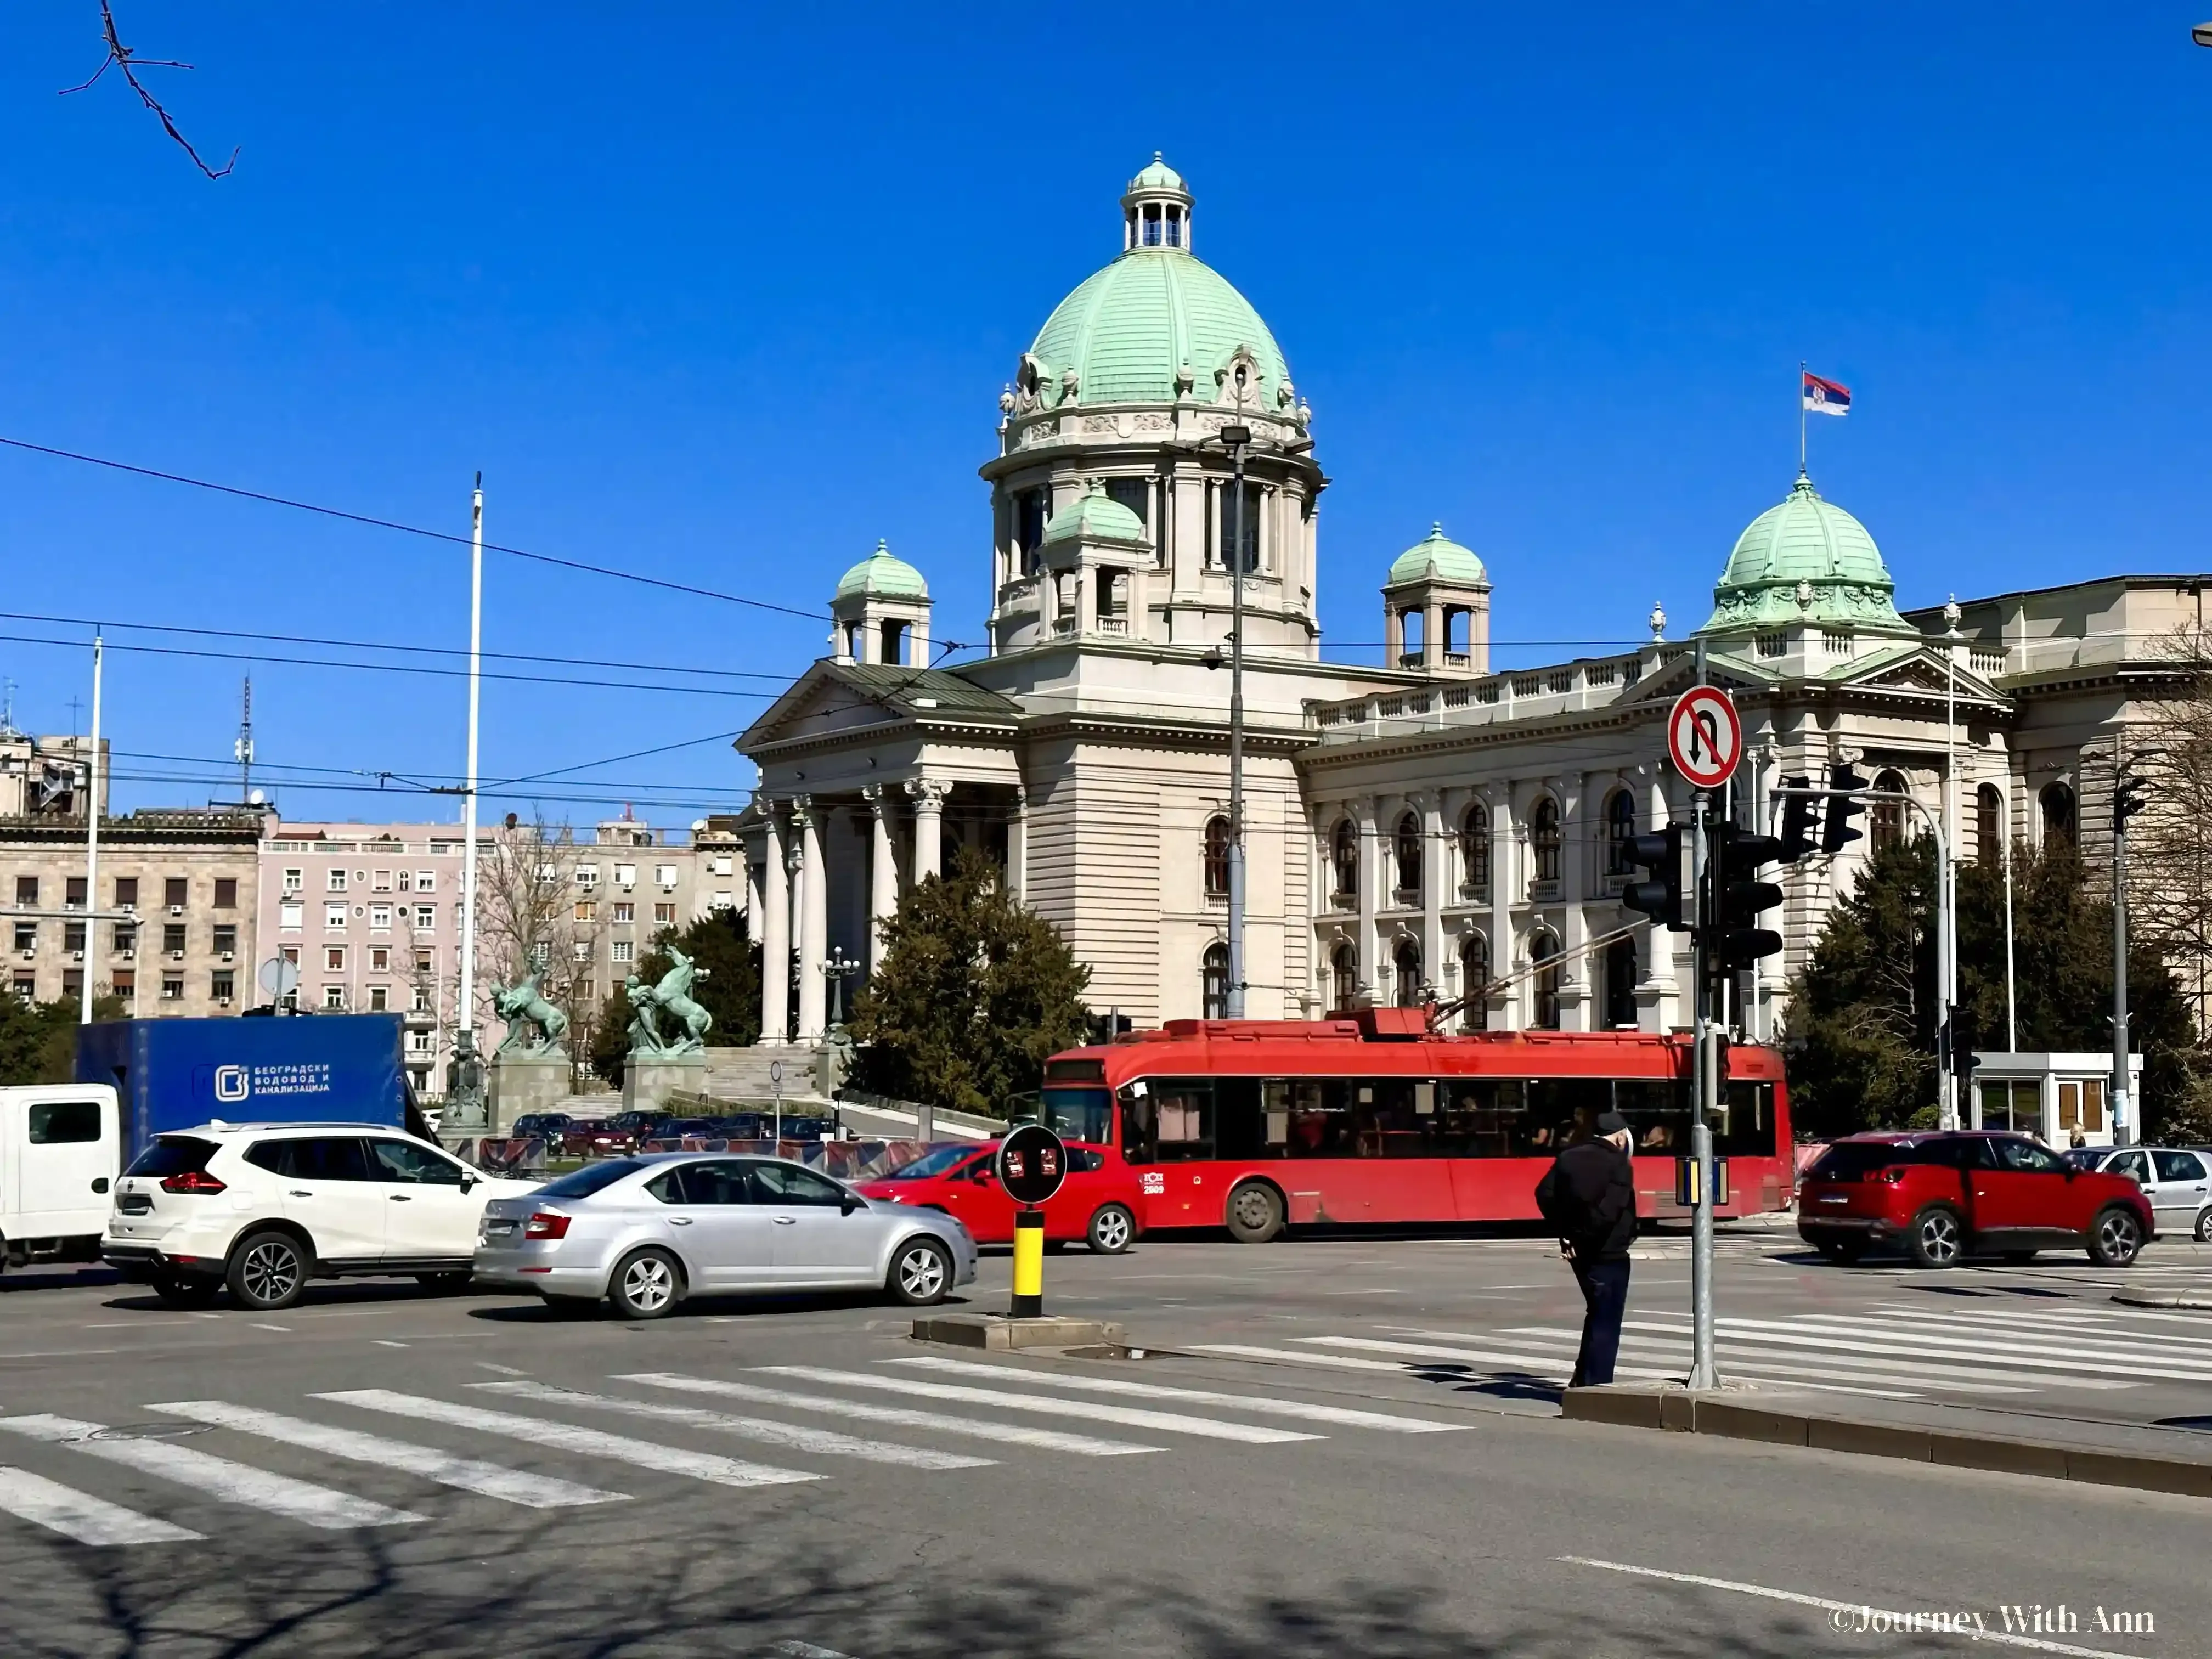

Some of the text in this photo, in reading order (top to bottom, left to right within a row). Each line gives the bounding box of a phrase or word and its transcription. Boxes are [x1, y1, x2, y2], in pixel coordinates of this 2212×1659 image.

[254, 1064, 329, 1075] БЕОГРАДСКИ
[255, 1075, 315, 1085] ВОДОВОД
[255, 1084, 329, 1095] КАНАЛИЗАЦИЈА
